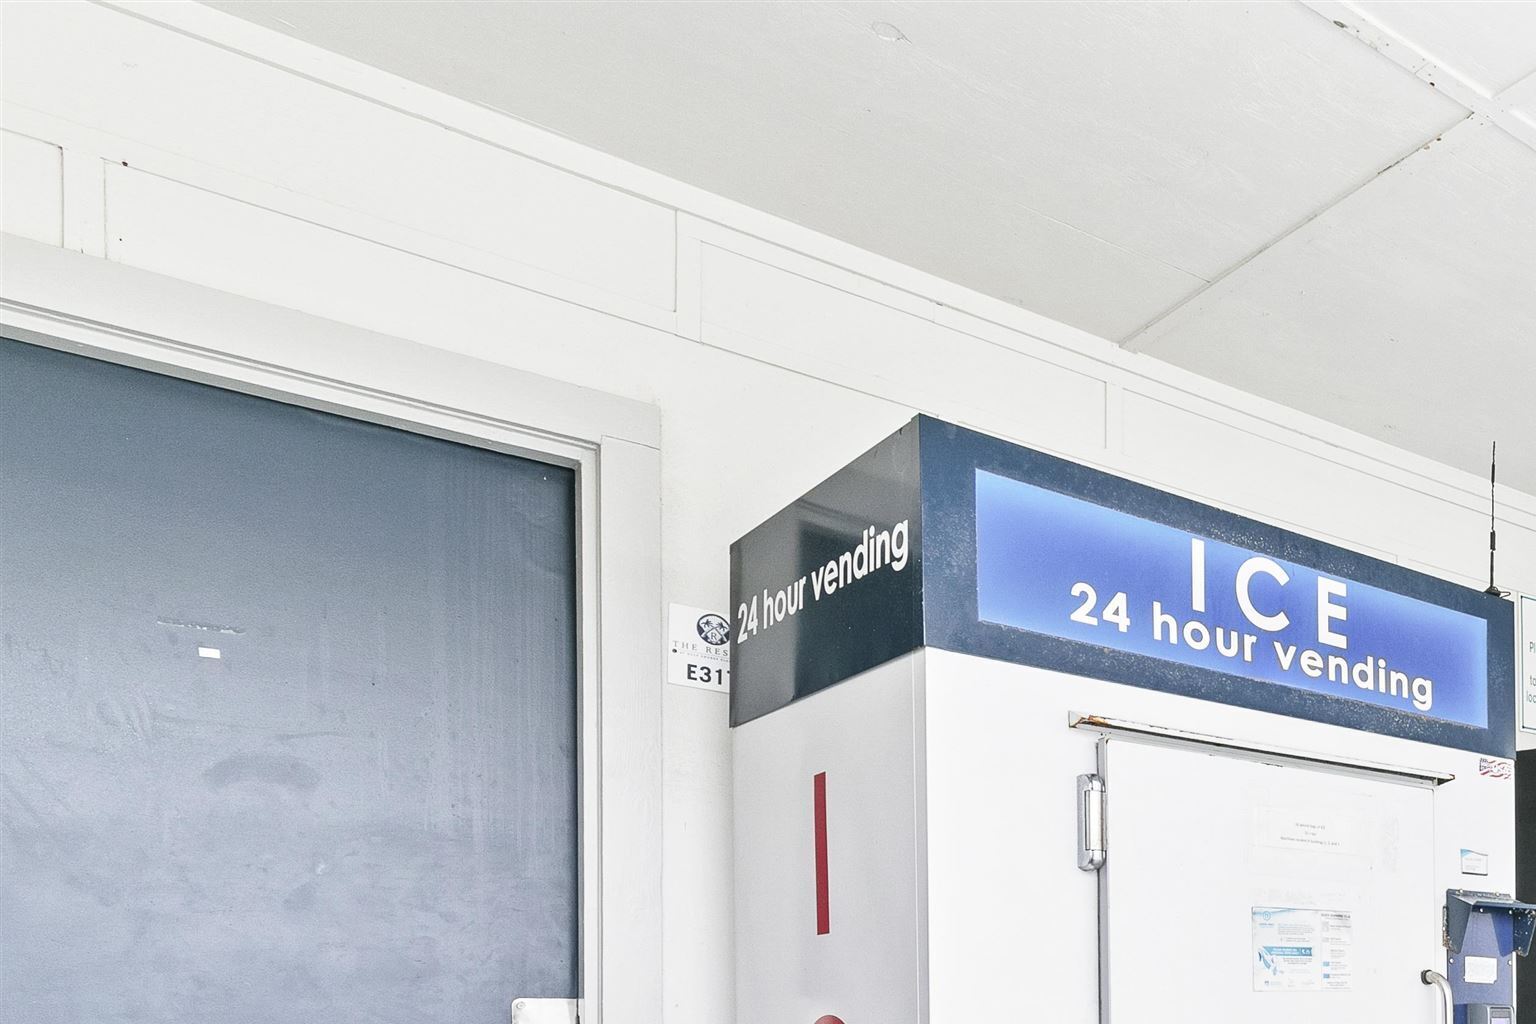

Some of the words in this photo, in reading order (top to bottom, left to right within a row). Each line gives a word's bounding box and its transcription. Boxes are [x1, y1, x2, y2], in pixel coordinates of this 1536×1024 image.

[737, 595, 758, 644] 24
[763, 576, 807, 629] hour
[811, 519, 909, 601] vending
[1191, 538, 1348, 649] ICE
[672, 640, 698, 651] THE
[705, 646, 730, 657] RES
[687, 663, 730, 685] E31
[1070, 581, 1131, 633] 24
[1152, 601, 1258, 662] hour
[1273, 640, 1433, 711] vending
[1530, 676, 1536, 687] to
